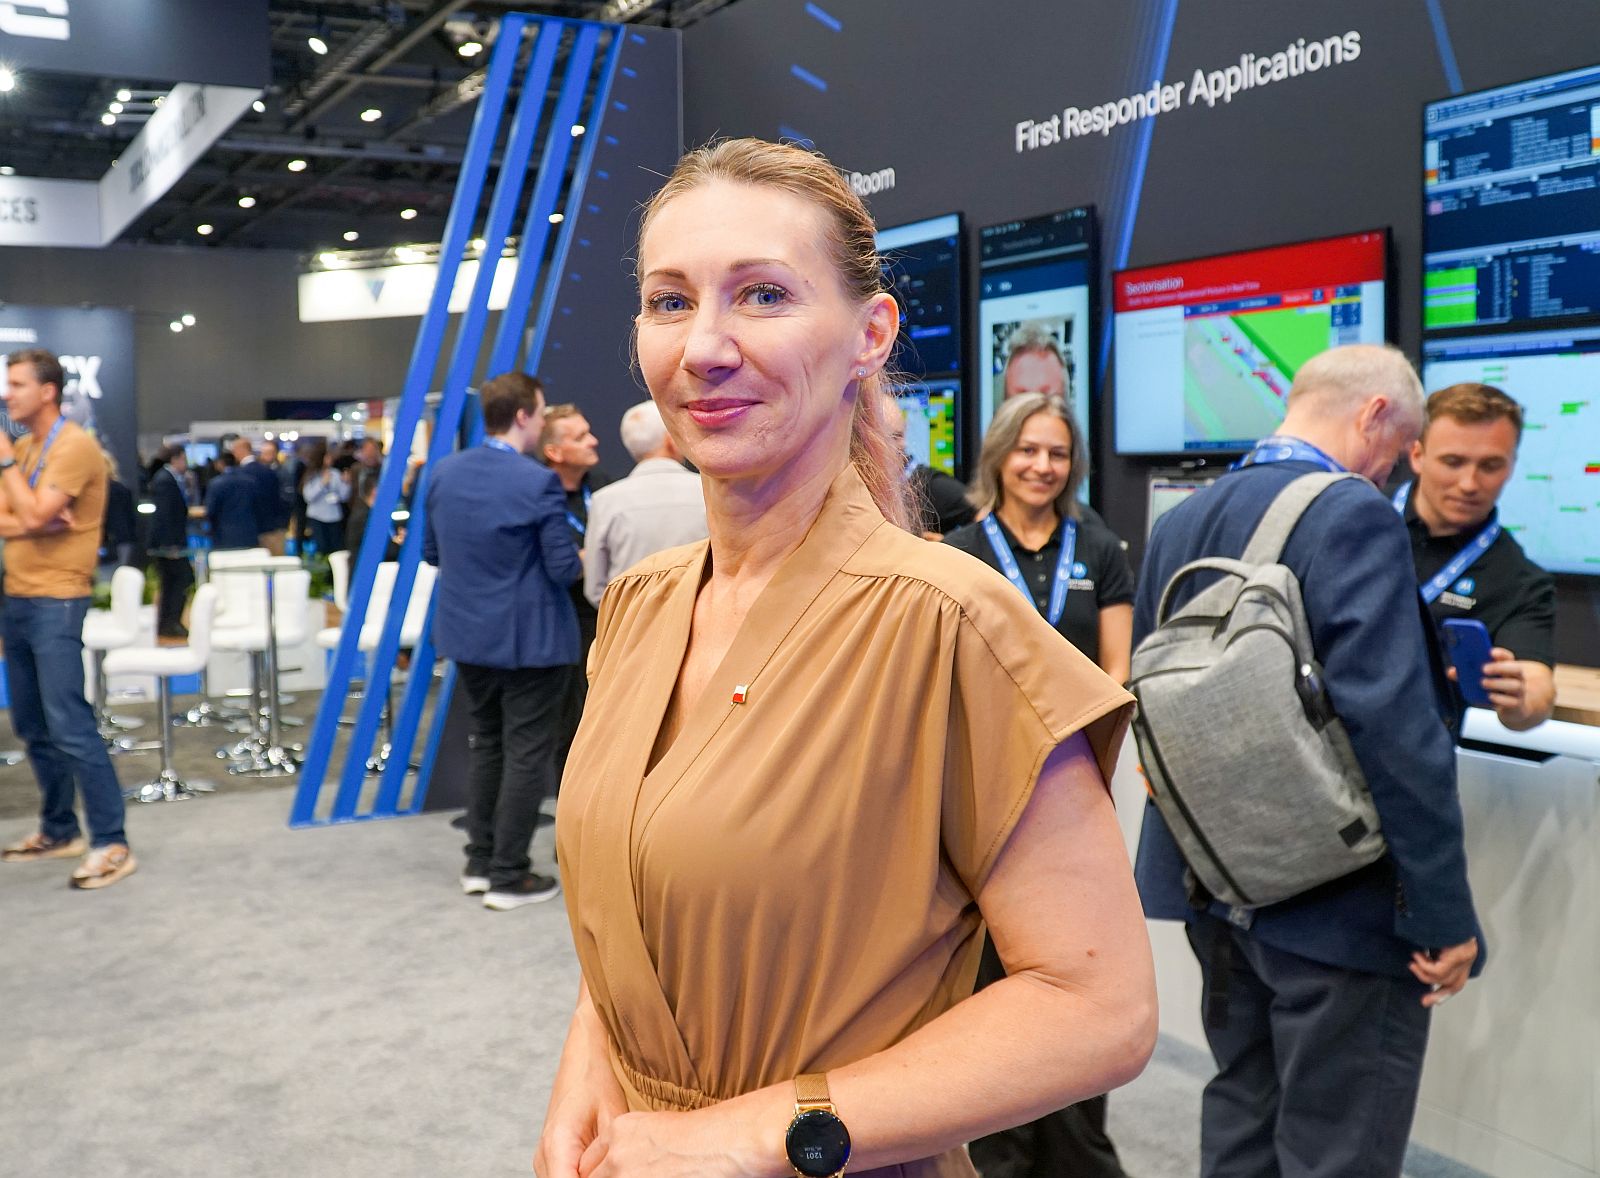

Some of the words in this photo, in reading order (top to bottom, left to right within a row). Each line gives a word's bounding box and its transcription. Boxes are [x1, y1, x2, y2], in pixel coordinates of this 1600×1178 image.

[1016, 114, 1061, 154] First
[1063, 79, 1186, 139] Responder
[1188, 30, 1362, 108] Applications
[850, 167, 895, 196] Room
